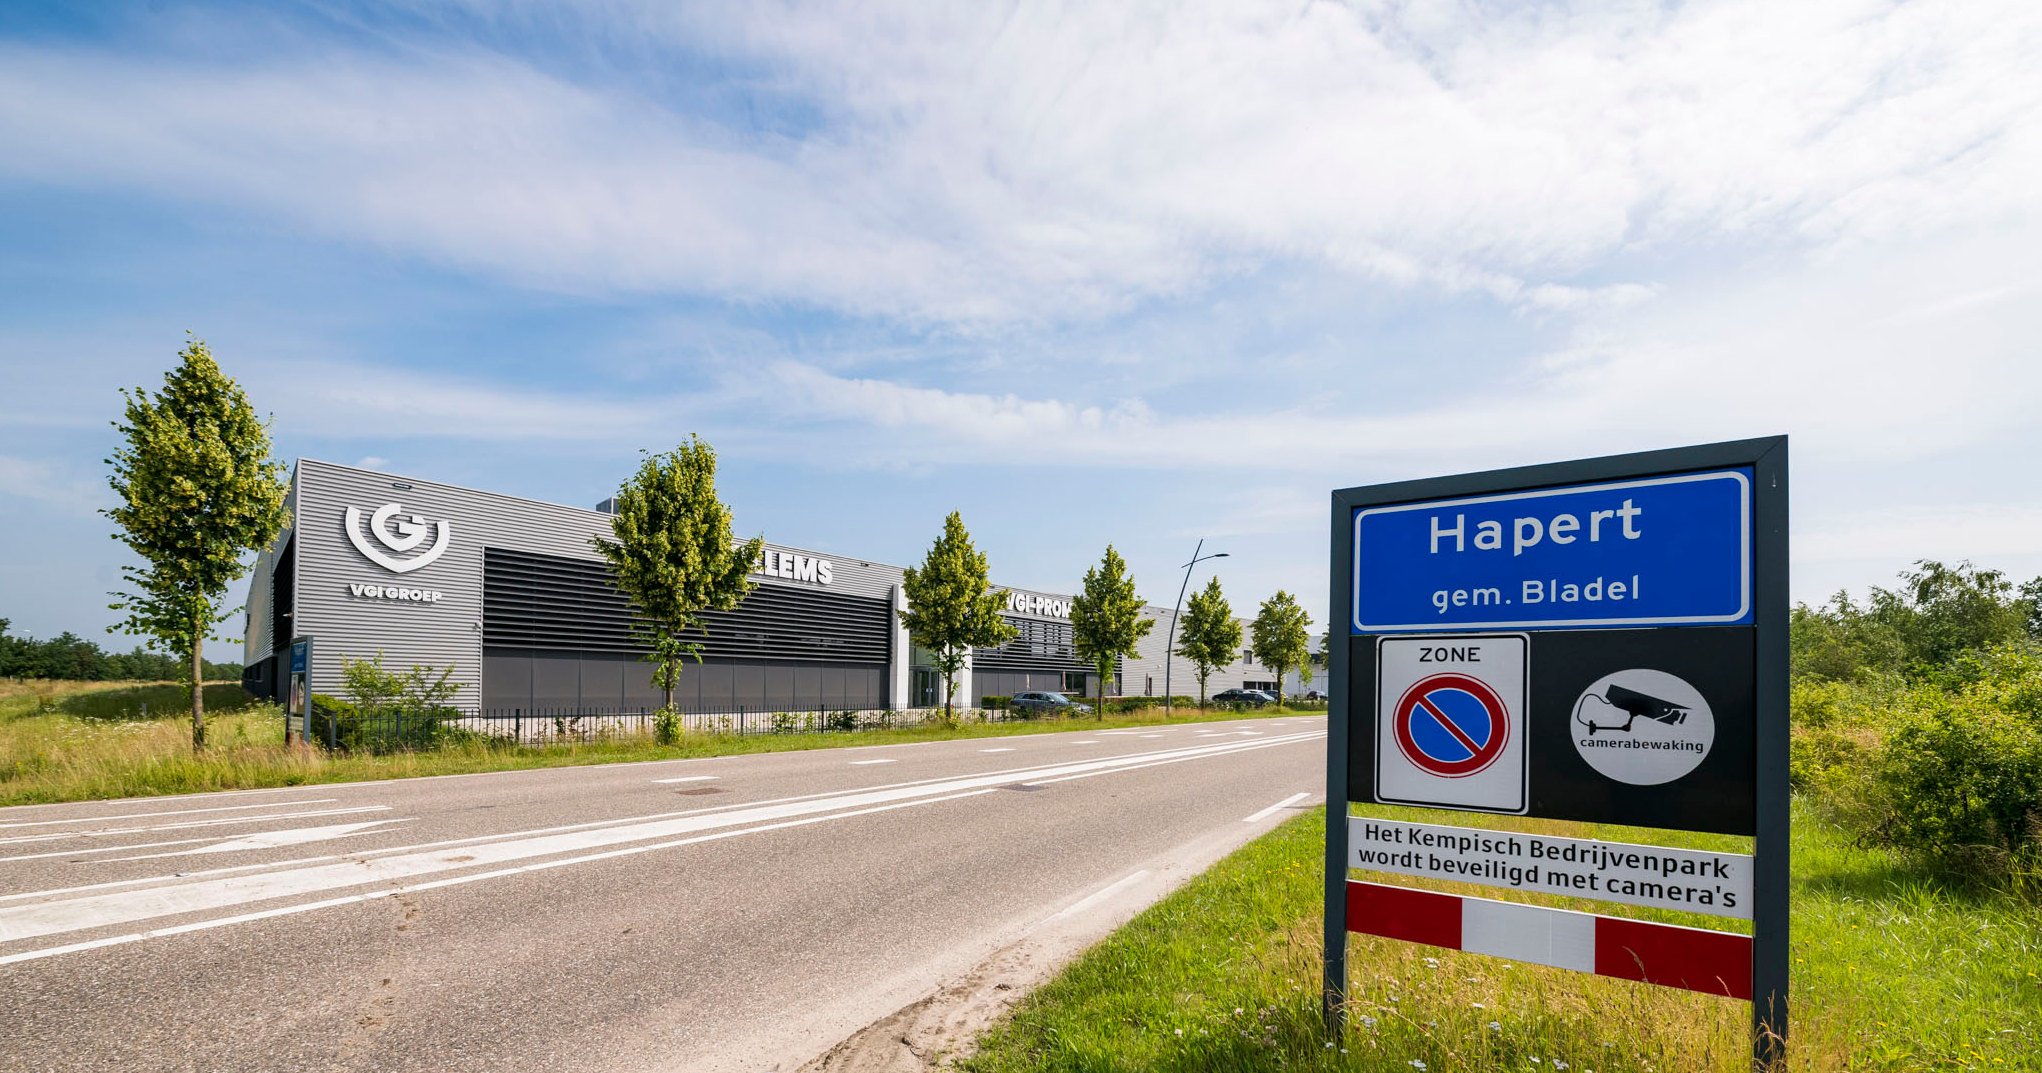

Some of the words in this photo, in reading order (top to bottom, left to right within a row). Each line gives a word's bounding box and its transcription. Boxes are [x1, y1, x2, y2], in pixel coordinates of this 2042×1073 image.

[1429, 498, 1642, 557] Hapert
[350, 583, 383, 598] VGI
[385, 587, 442, 602] GROEP
[1432, 585, 1512, 615] gem.
[1521, 575, 1640, 605] Bladel
[1419, 647, 1481, 663] ZONE
[1580, 737, 1705, 754] camerabewaking
[1365, 824, 1403, 844] Het
[1408, 828, 1523, 856] Kempisch
[1530, 840, 1730, 880] Bedrijvenpark
[1359, 849, 1423, 870] wordt
[1429, 853, 1539, 887] beveiligd
[1547, 871, 1600, 891] met
[1606, 877, 1737, 908] camera's
